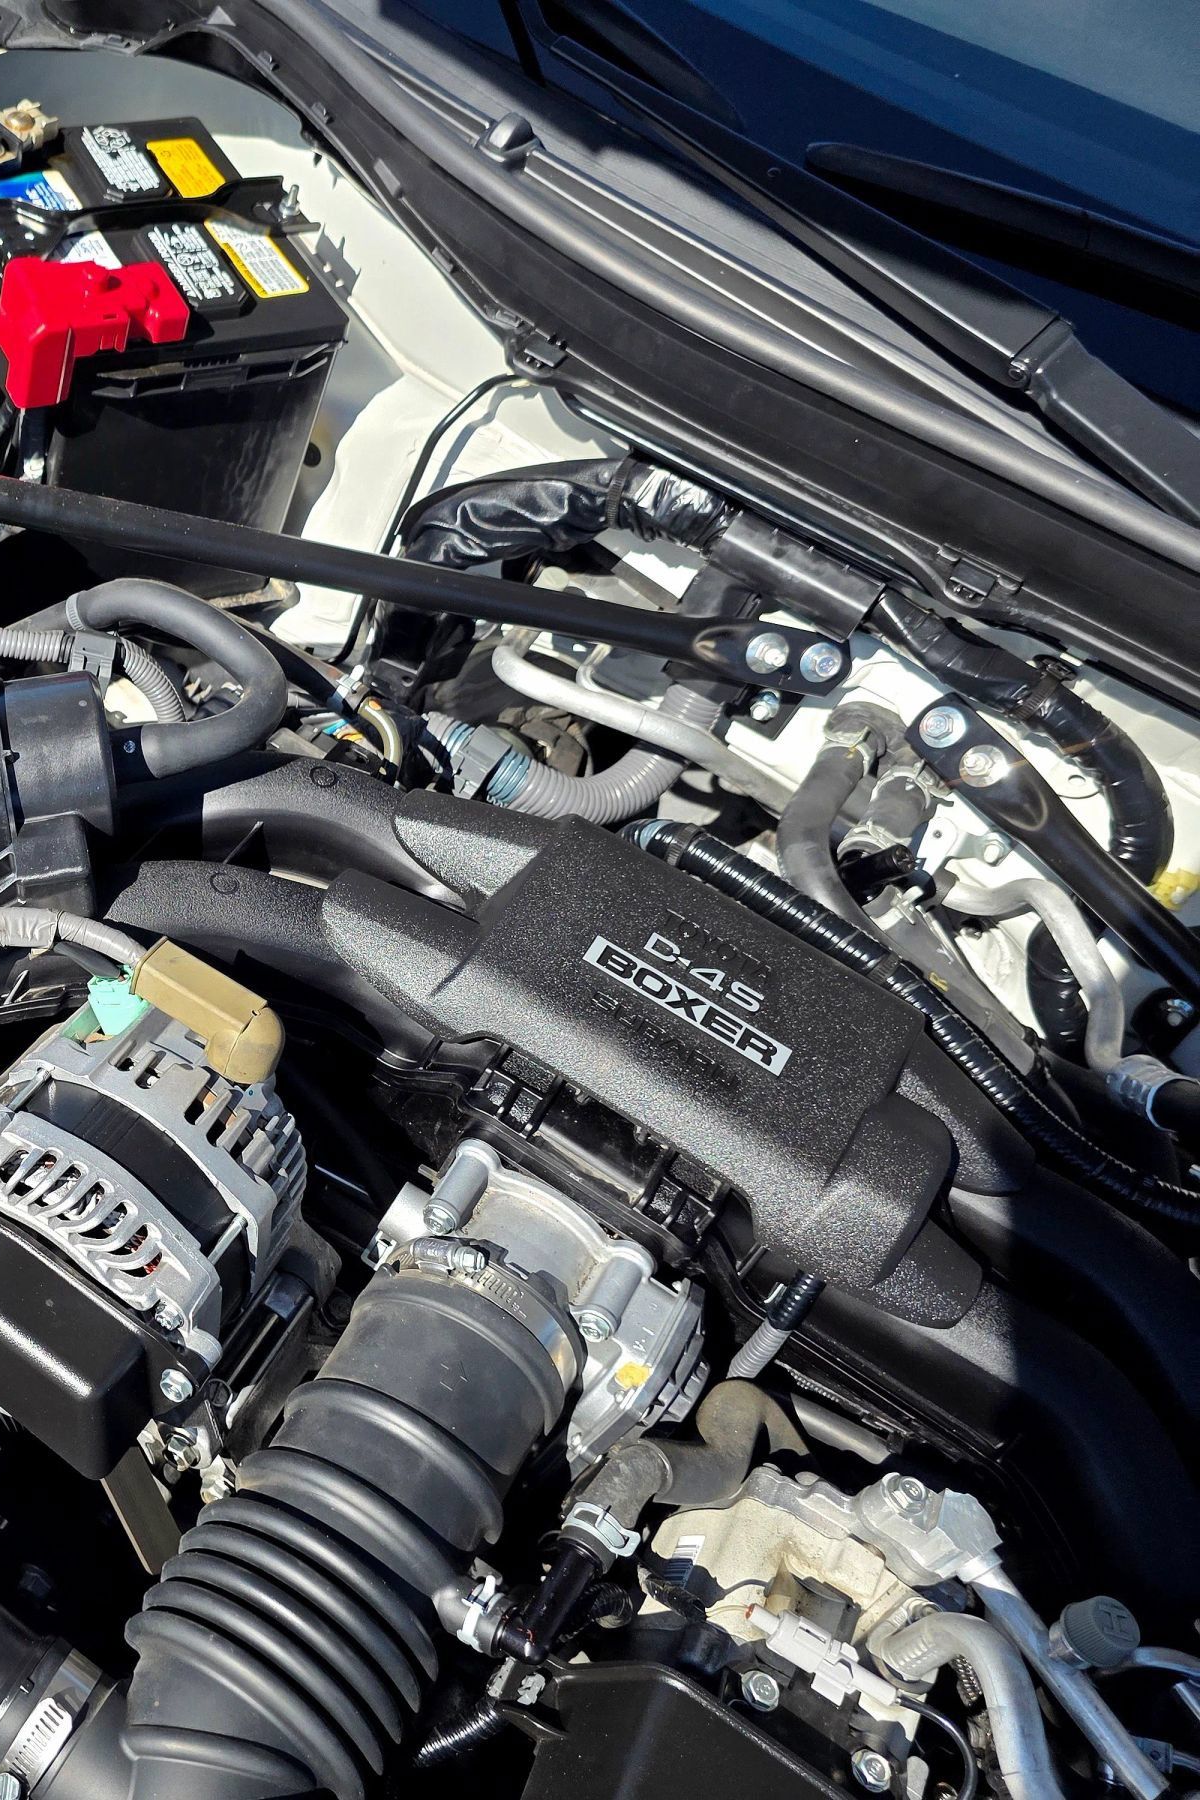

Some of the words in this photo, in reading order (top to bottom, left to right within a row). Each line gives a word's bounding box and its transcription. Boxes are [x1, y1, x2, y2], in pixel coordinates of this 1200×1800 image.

[663, 908, 772, 985] TOYOTA
[592, 990, 740, 1090] SUBARU
[596, 944, 778, 1067] BOXER
